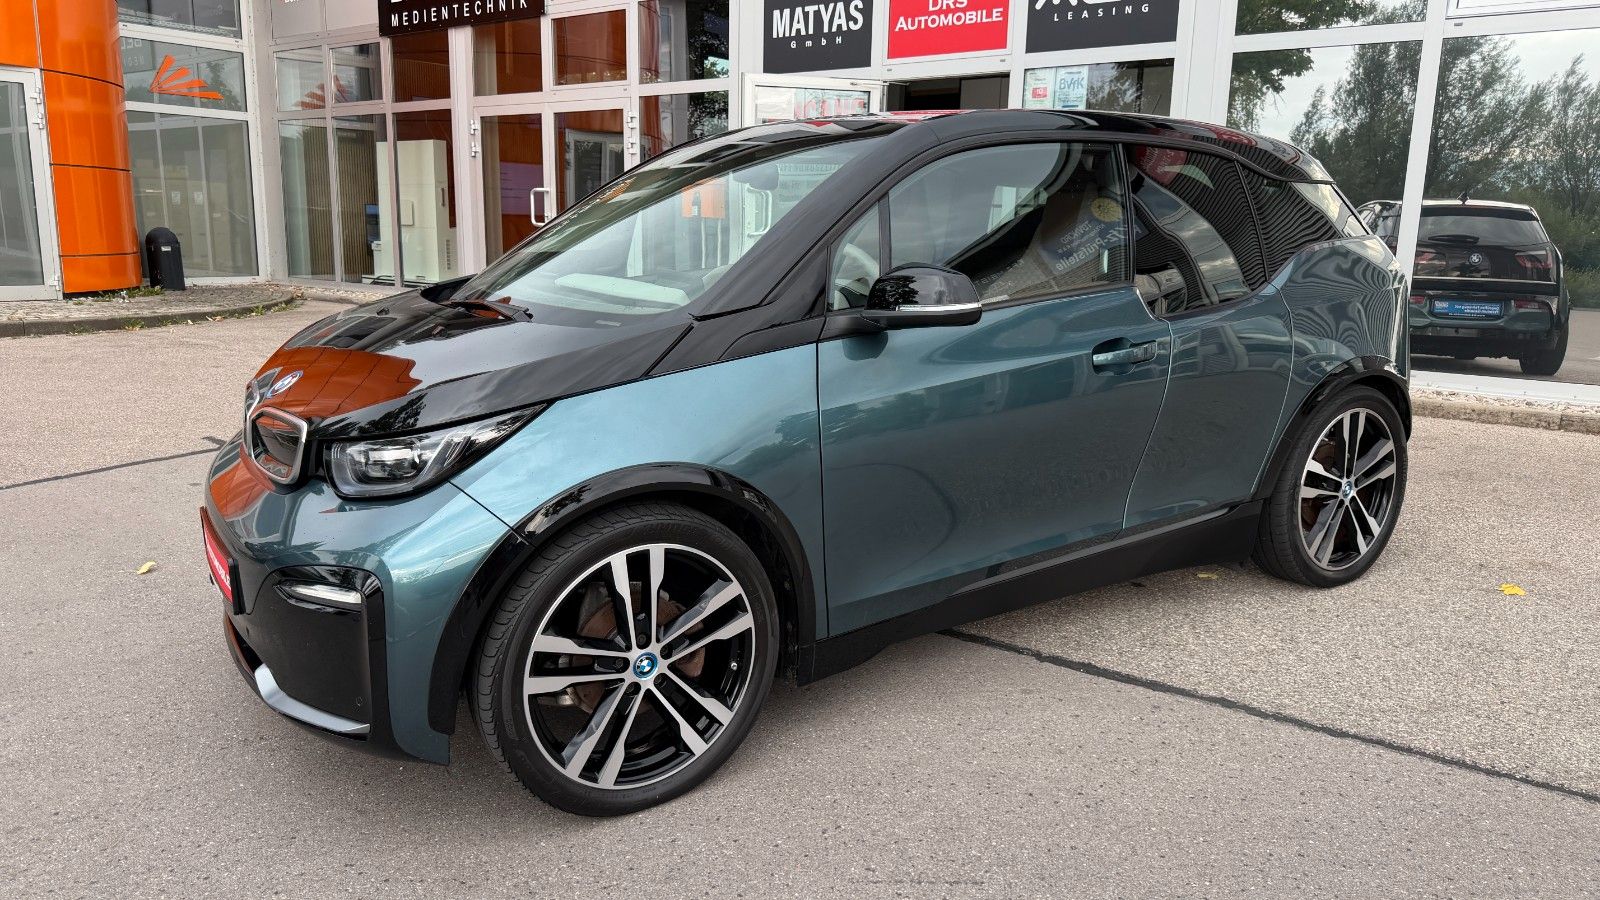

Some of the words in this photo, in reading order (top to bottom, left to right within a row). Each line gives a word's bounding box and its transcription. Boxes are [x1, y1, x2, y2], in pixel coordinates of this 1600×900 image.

[391, 0, 528, 27] MEDIENTECHNIK
[772, 0, 864, 39] MATYAS
[895, 8, 1004, 32] AUTOMOBILE
[1053, 3, 1149, 21] LEASING
